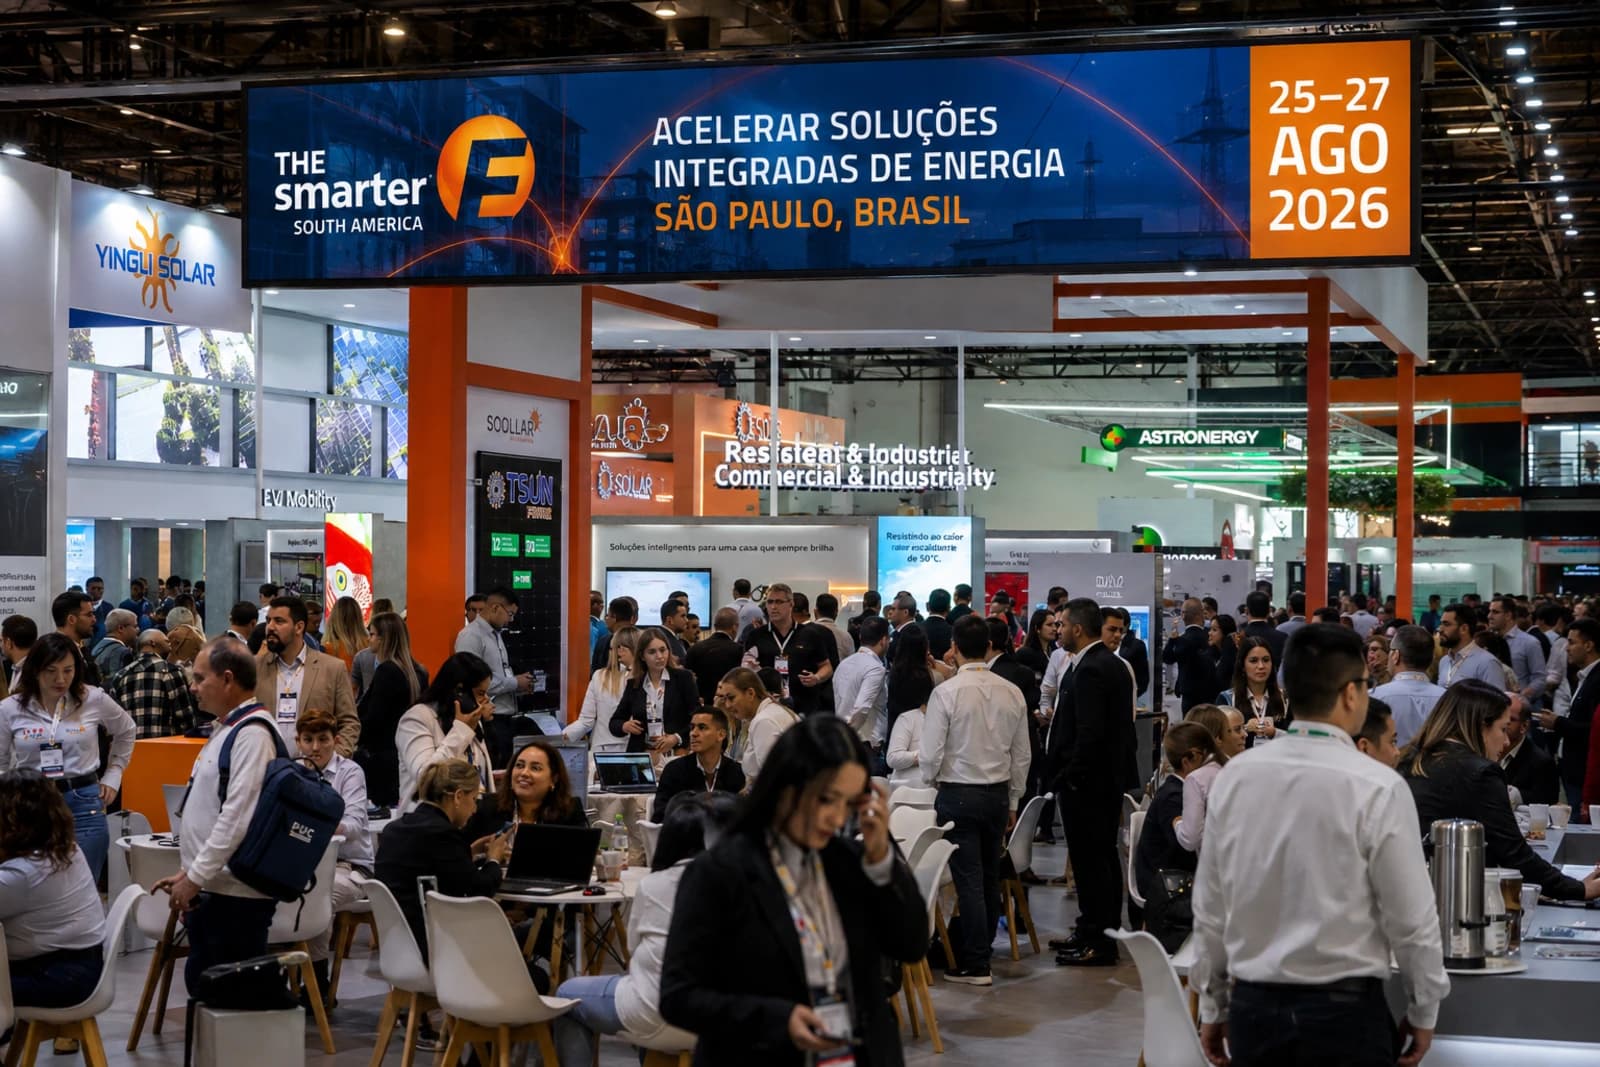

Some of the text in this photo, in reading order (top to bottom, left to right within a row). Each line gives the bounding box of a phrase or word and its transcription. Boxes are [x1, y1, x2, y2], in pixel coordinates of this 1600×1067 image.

[652, 100, 999, 146] ACELERAR SOLUÇÕES
[274, 150, 326, 176] THE
[1268, 123, 1389, 176] AGO
[654, 148, 1066, 188] INTEGRADAS DE ENERGIA
[274, 173, 427, 211] smarter
[654, 194, 971, 232] SÃO PAULO, BRASIL
[1269, 187, 1390, 231] 2026
[293, 216, 424, 235] SOUTH AMERICA
[158, 255, 216, 287] SOLAR
[1138, 430, 1260, 445] ASTRONERGY
[846, 442, 863, 464] &
[714, 463, 841, 487] Commercial
[847, 464, 864, 486] &
[698, 545, 717, 553] para
[760, 545, 776, 553] que
[907, 554, 918, 562] de
